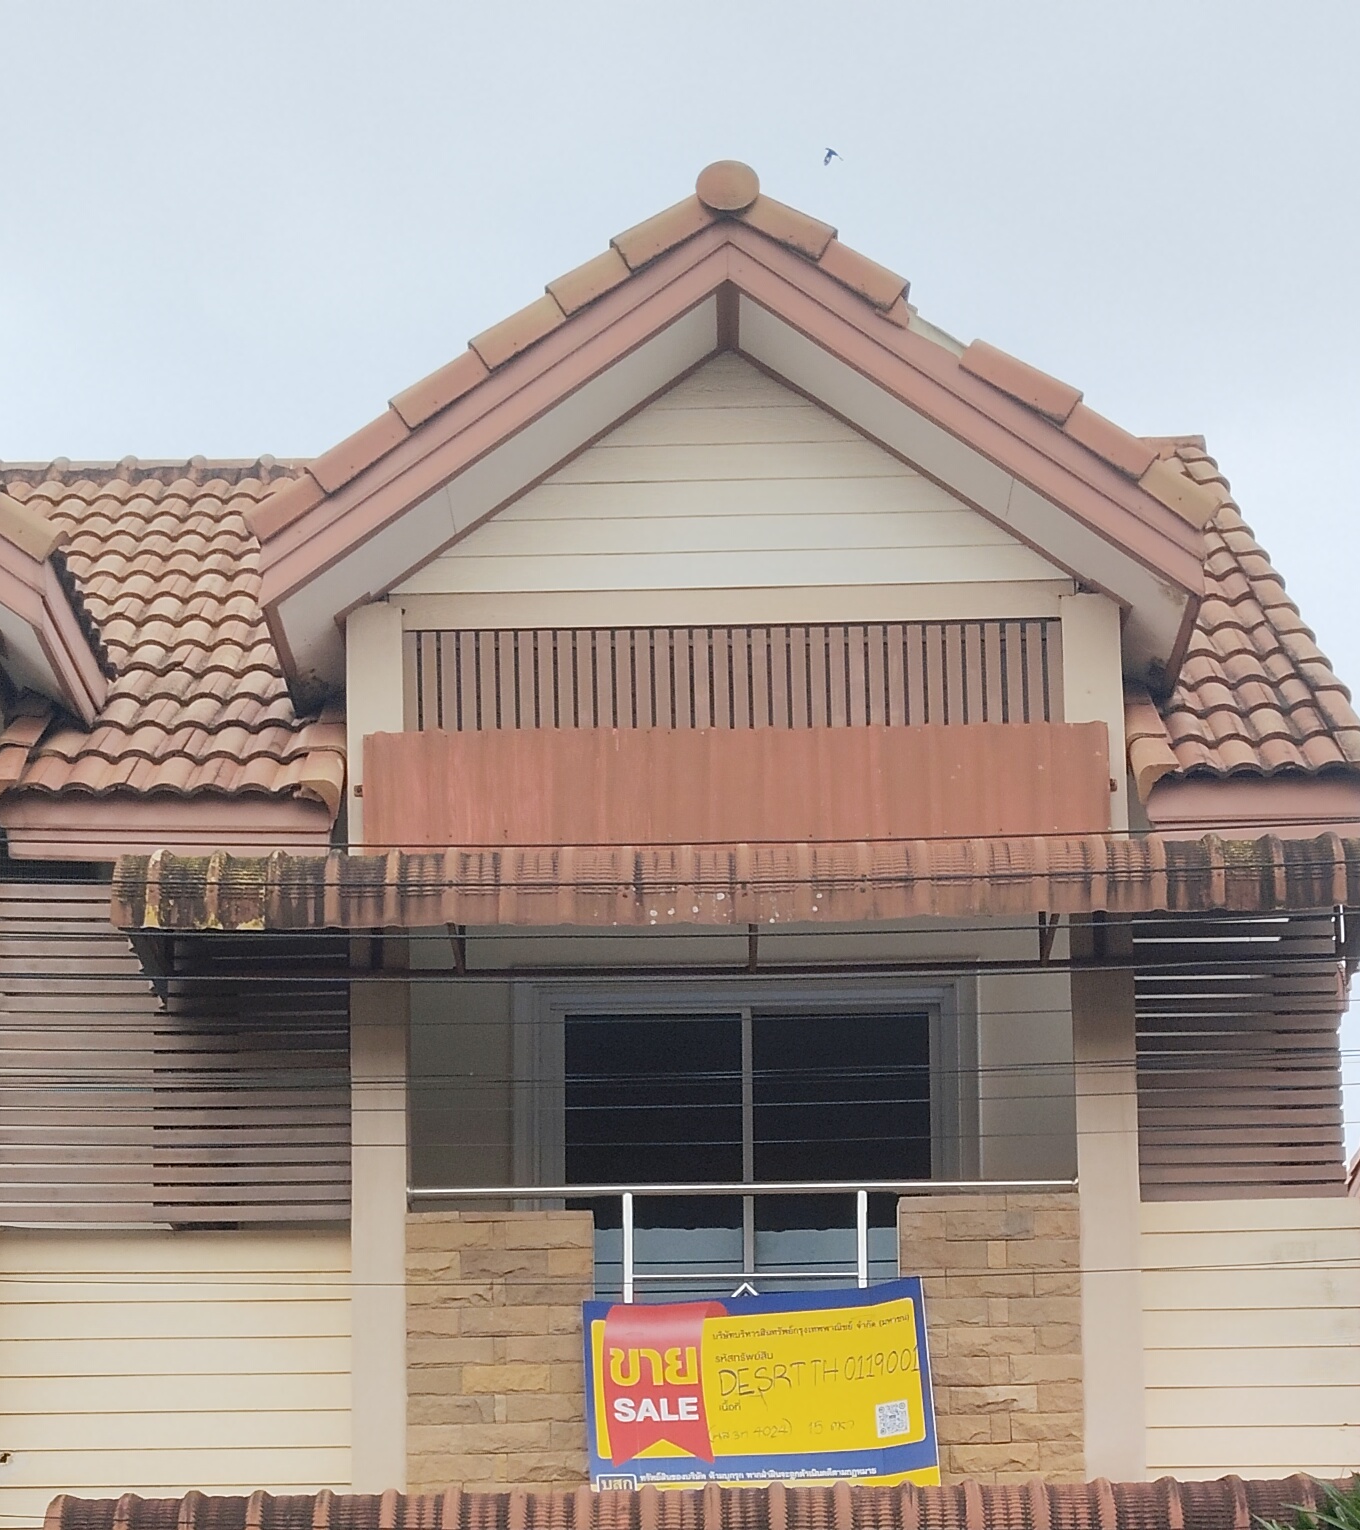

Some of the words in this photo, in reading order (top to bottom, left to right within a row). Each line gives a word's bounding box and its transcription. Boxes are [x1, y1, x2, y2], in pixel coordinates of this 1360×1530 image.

[609, 1346, 699, 1387] ขาย
[714, 1350, 774, 1363] รหัสทรัพย์สิน
[614, 1396, 700, 1423] SALE
